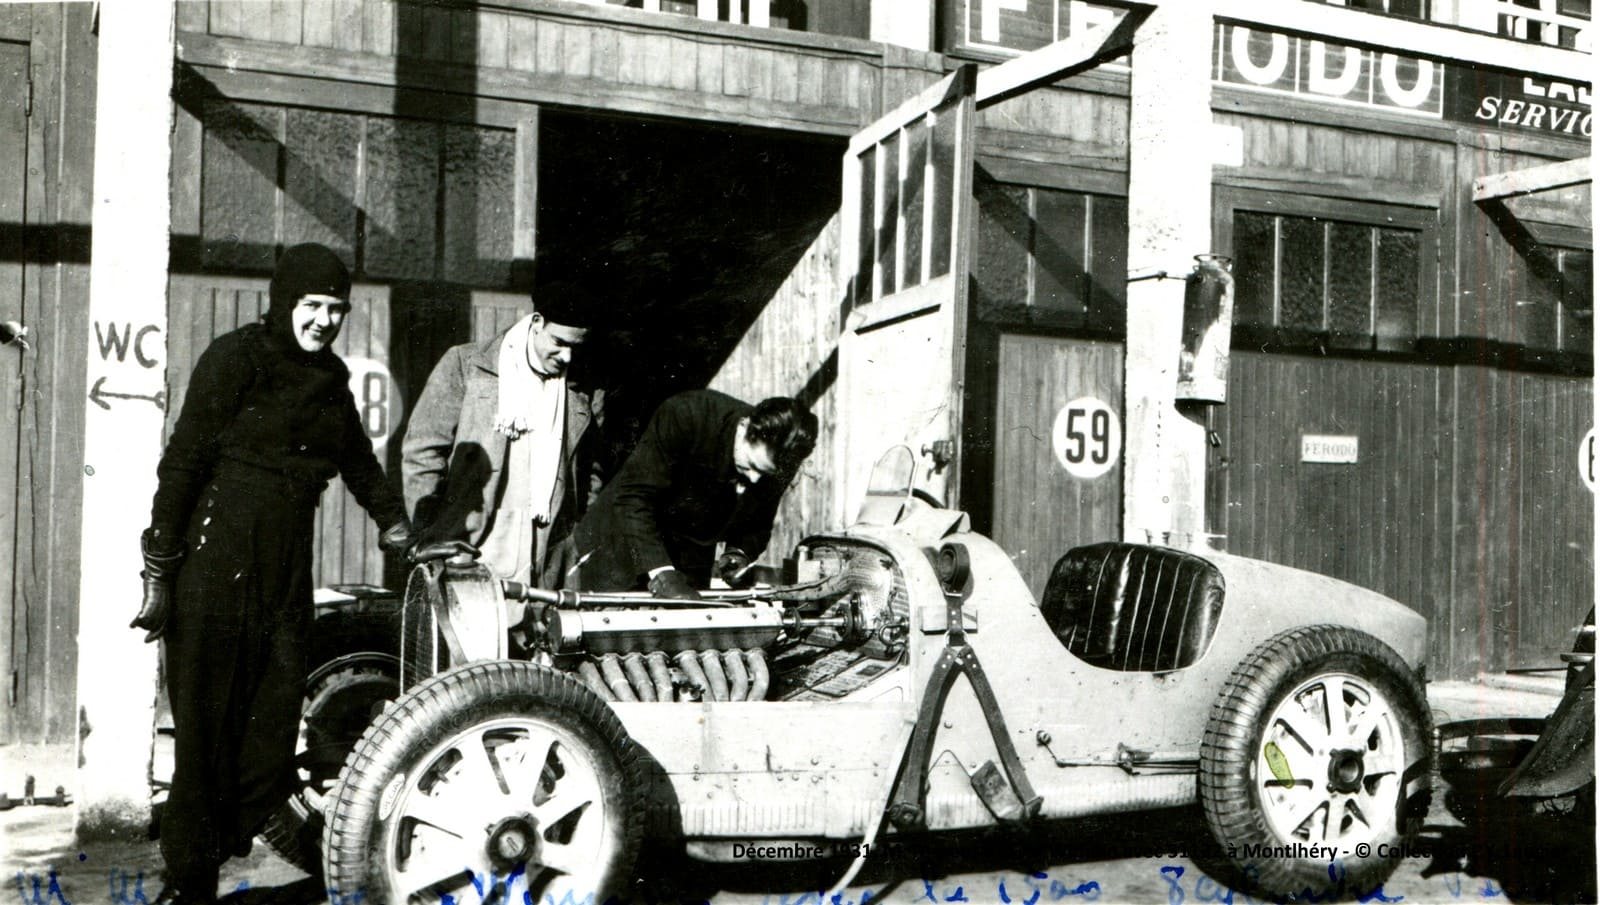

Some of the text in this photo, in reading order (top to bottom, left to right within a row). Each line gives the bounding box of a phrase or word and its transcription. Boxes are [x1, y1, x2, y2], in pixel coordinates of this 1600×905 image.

[94, 321, 161, 369] WC
[1066, 408, 1110, 464] 59
[1304, 441, 1357, 457] FERODO
